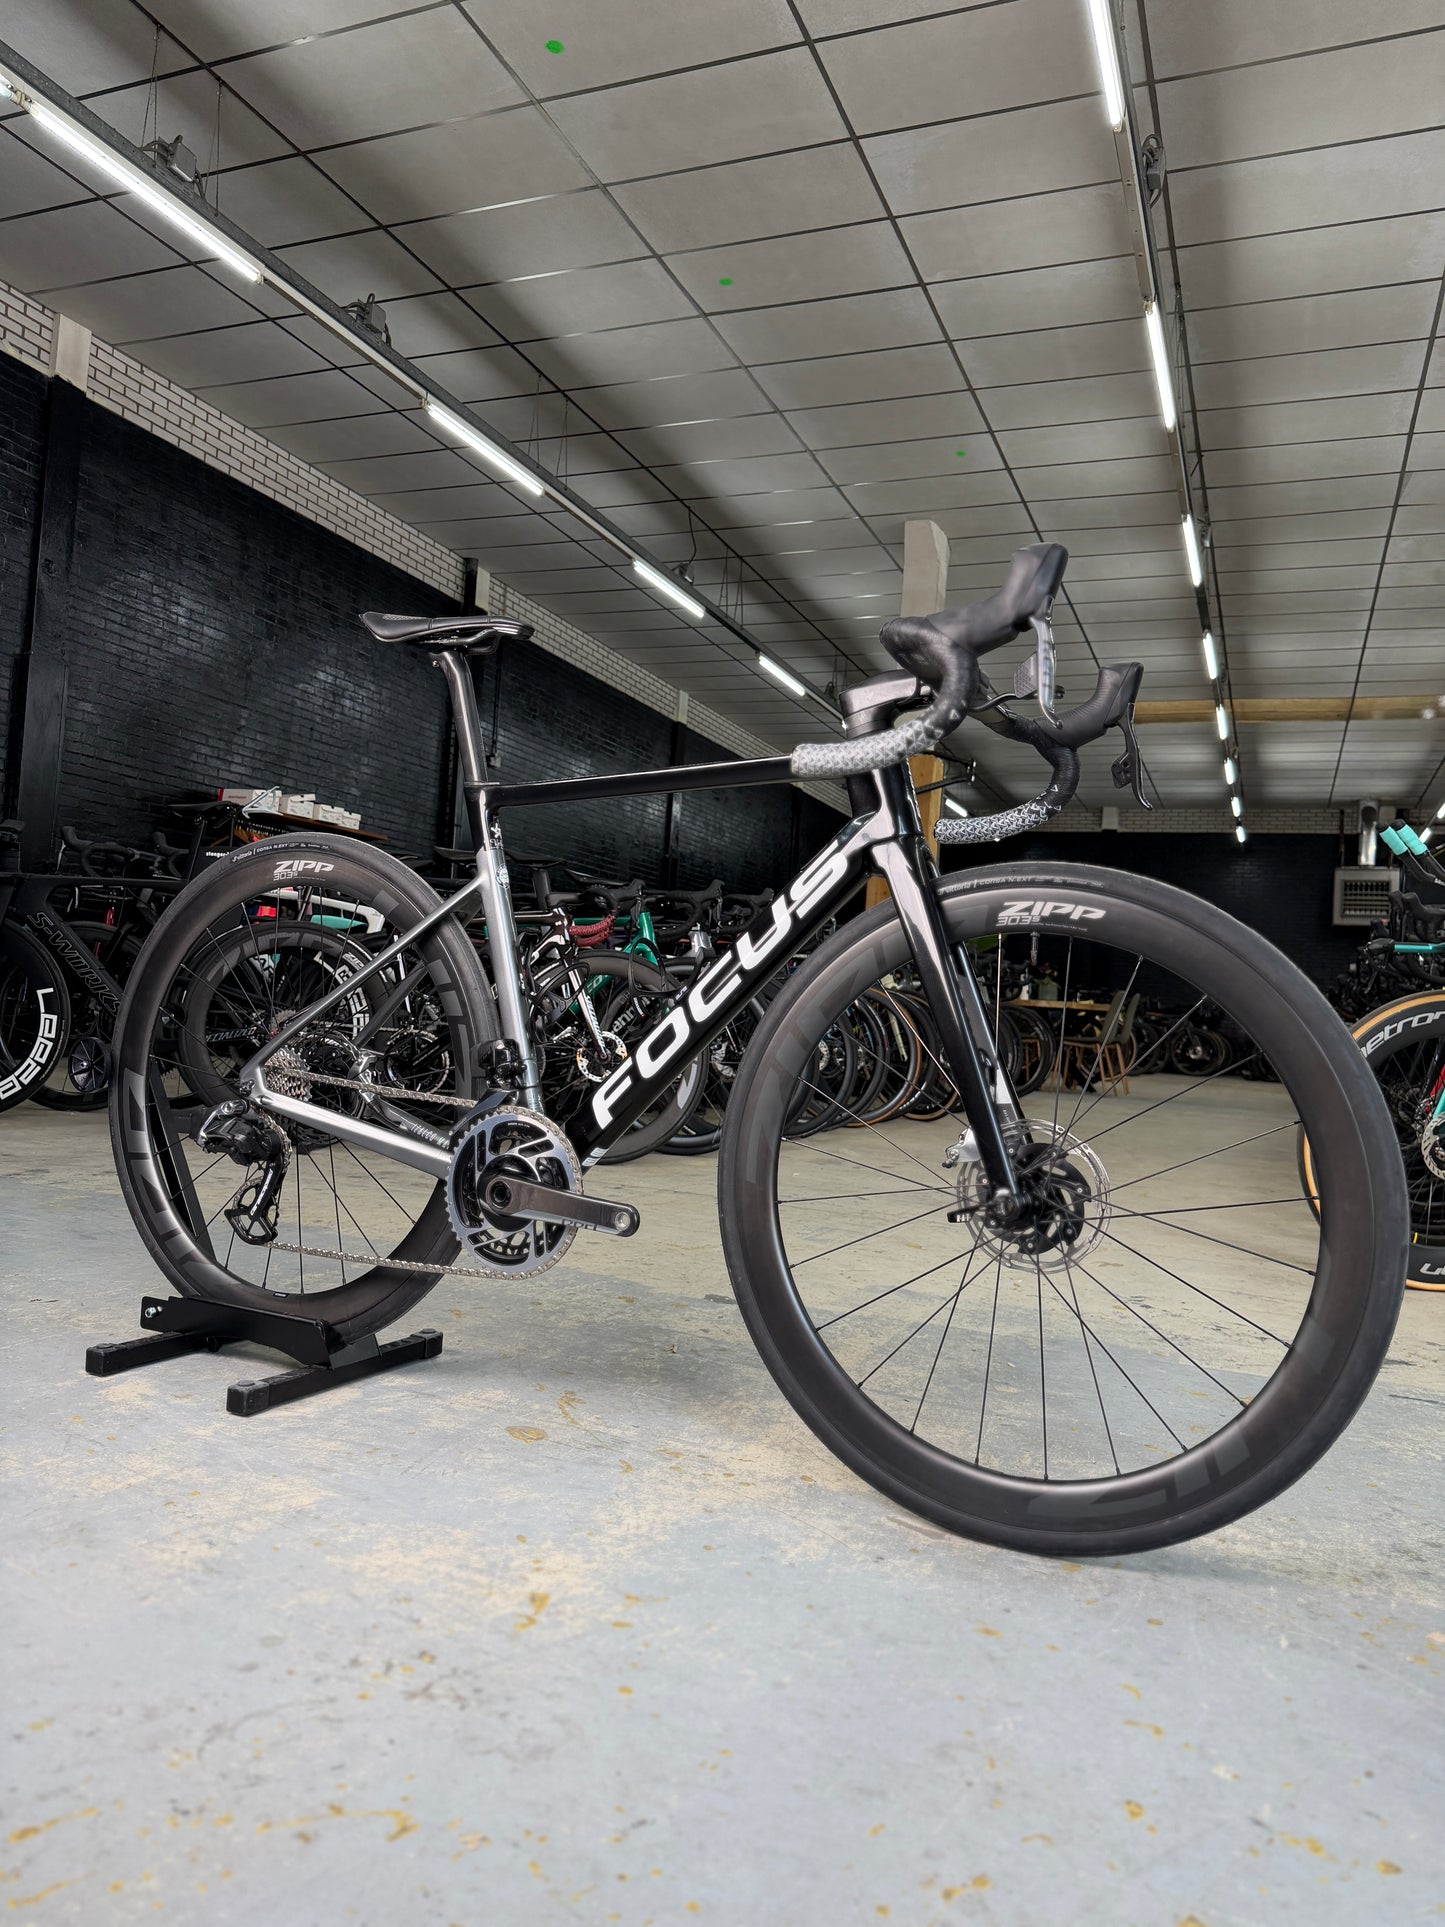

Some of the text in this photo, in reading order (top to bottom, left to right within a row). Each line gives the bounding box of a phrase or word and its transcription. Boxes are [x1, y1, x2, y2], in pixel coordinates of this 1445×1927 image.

[273, 859, 335, 873] ZIPP
[998, 900, 1107, 920] ZIPP
[592, 840, 848, 1130] FOCUS
